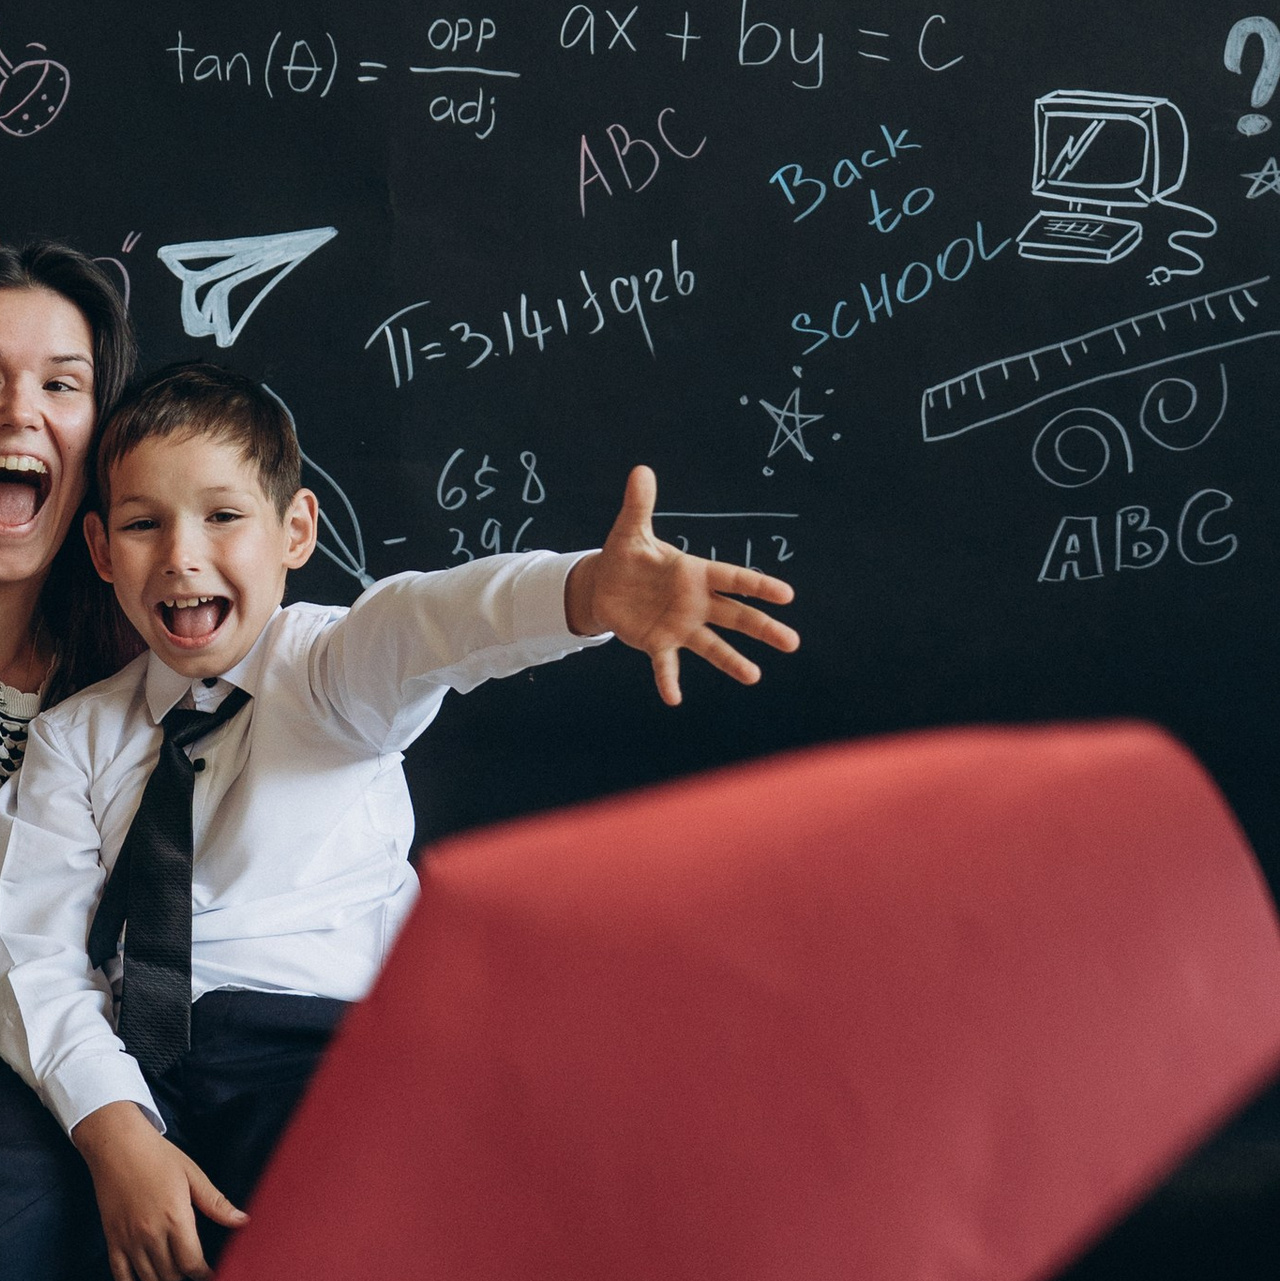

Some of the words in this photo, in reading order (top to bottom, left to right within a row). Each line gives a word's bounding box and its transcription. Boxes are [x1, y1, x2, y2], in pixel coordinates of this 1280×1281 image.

[428, 87, 497, 141] adj
[578, 106, 707, 218] ABC
[768, 123, 926, 225] Back
[867, 186, 936, 234] to
[790, 217, 1013, 356] SCHOOL
[1036, 483, 1239, 583] ABC
